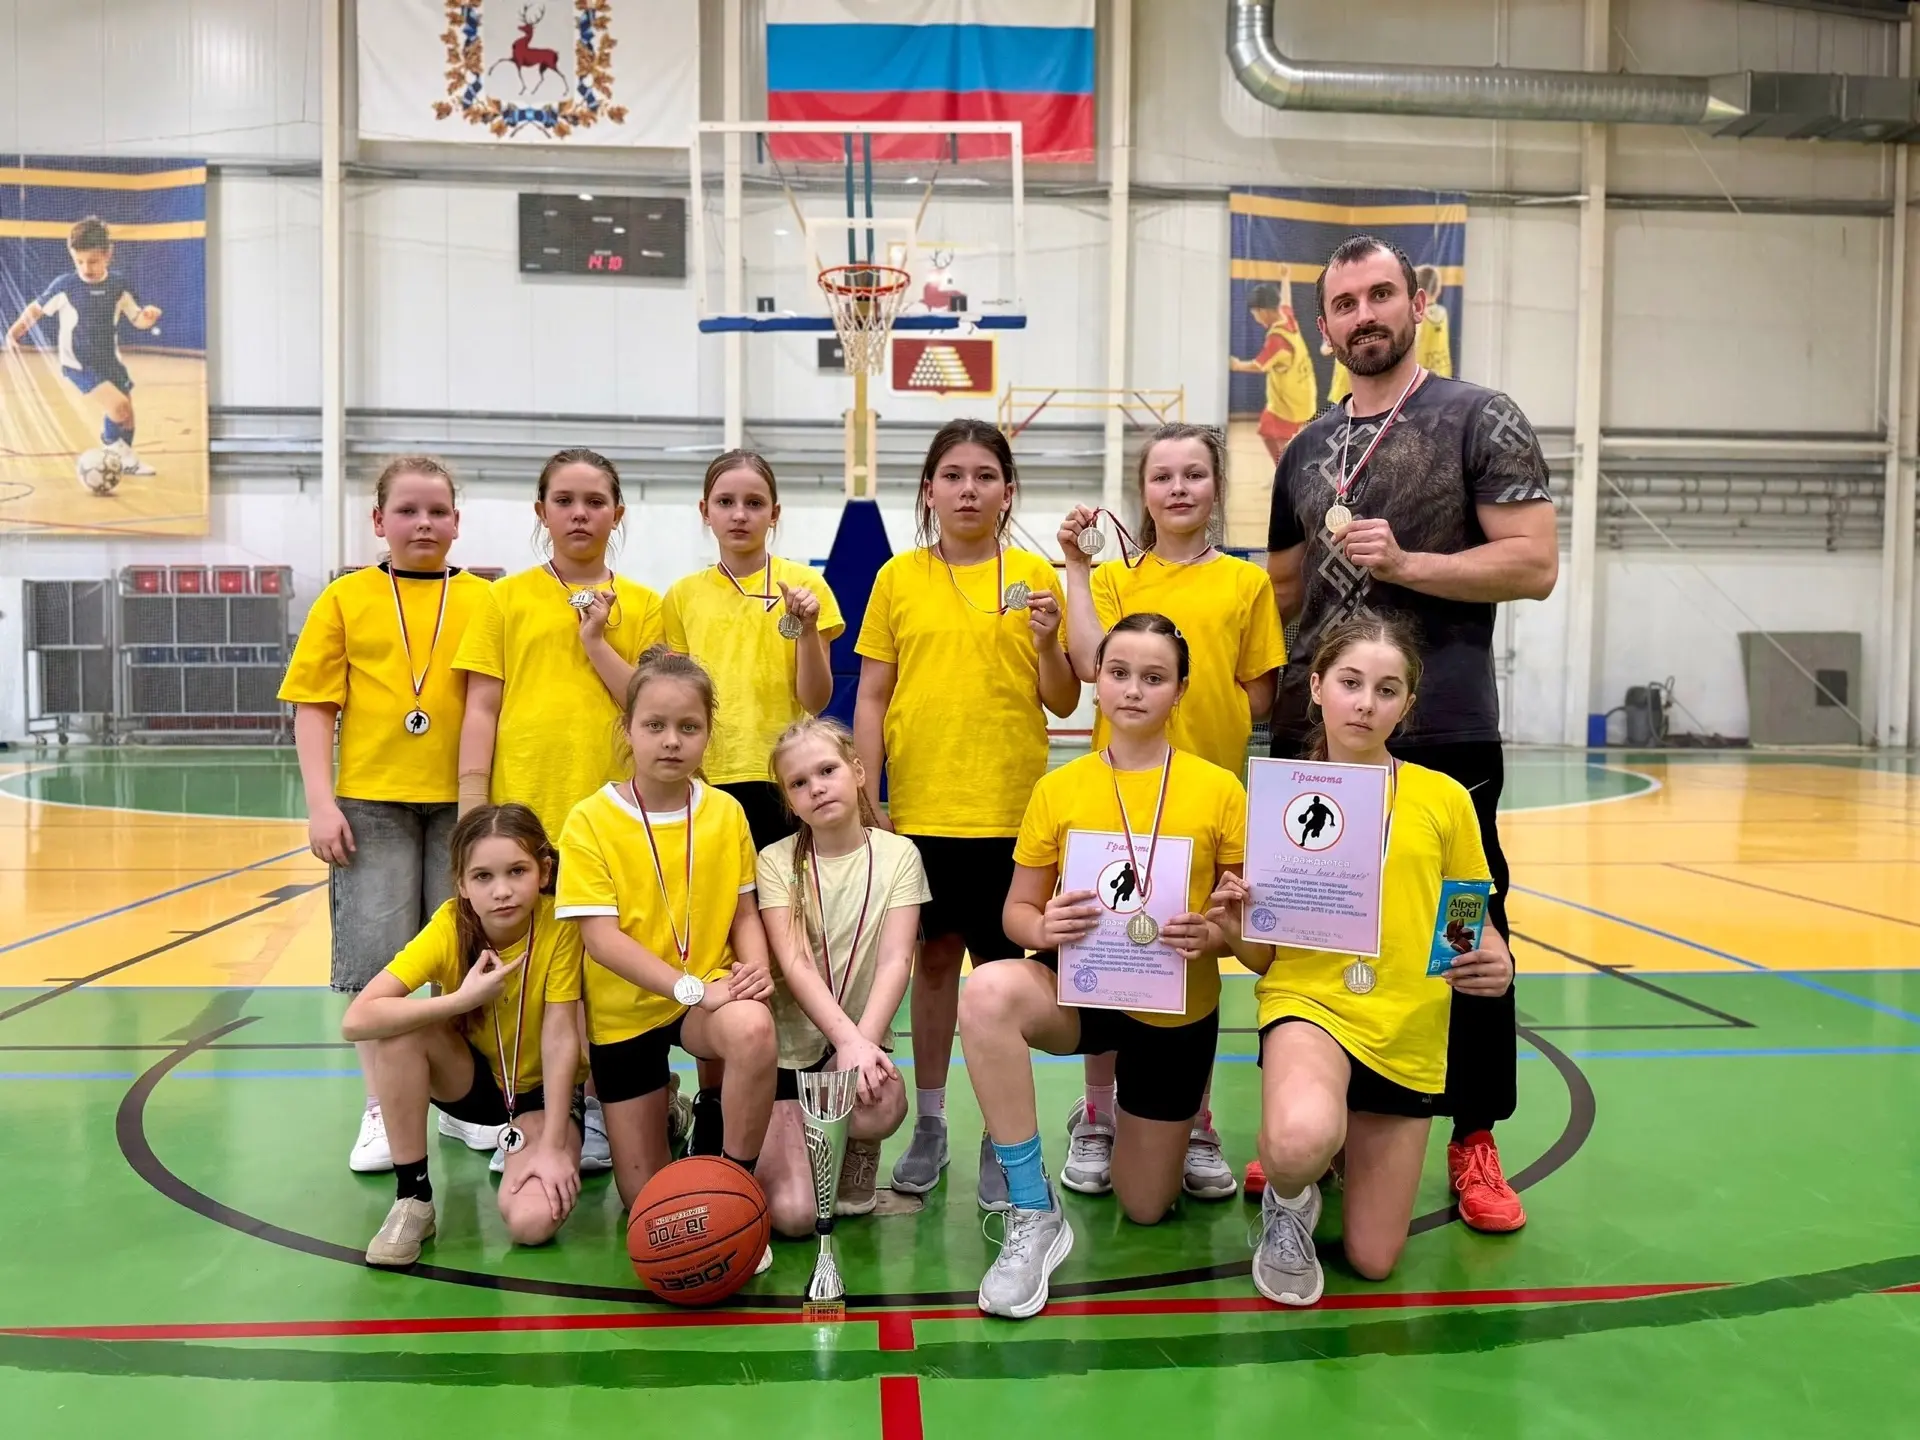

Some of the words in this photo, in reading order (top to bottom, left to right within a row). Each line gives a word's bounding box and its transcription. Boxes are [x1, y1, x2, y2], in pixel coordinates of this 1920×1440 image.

[1291, 770, 1342, 784] Грамота
[1274, 854, 1350, 867] Награждается
[1449, 898, 1482, 910] Alpen
[1450, 908, 1477, 918] Gold
[648, 1216, 708, 1246] JB-700
